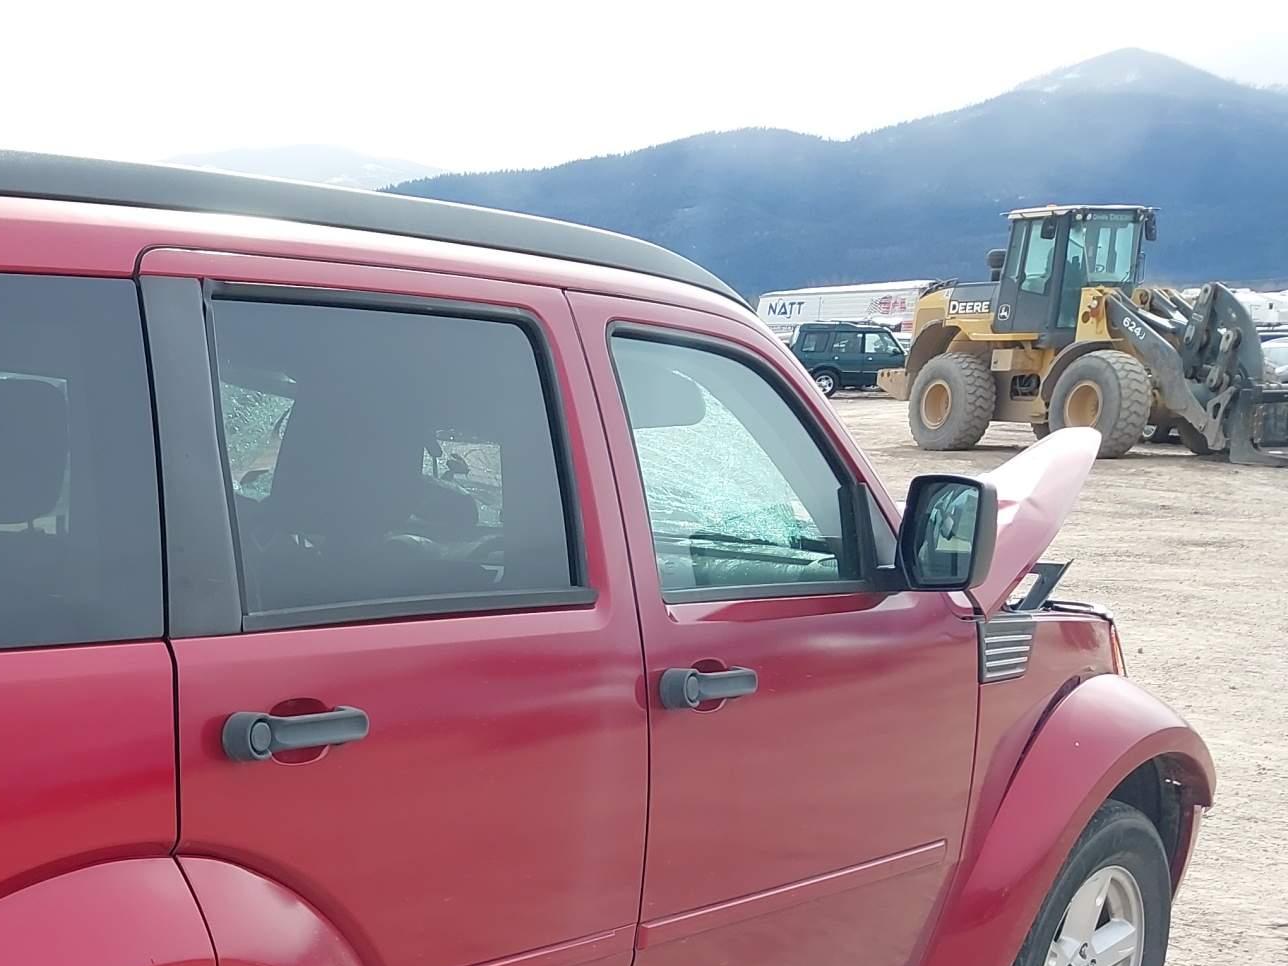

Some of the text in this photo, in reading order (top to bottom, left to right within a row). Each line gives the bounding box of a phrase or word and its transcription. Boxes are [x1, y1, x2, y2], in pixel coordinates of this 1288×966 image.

[767, 299, 805, 318] NATT
[949, 301, 990, 314] DEERE
[1122, 316, 1146, 340] 624J
